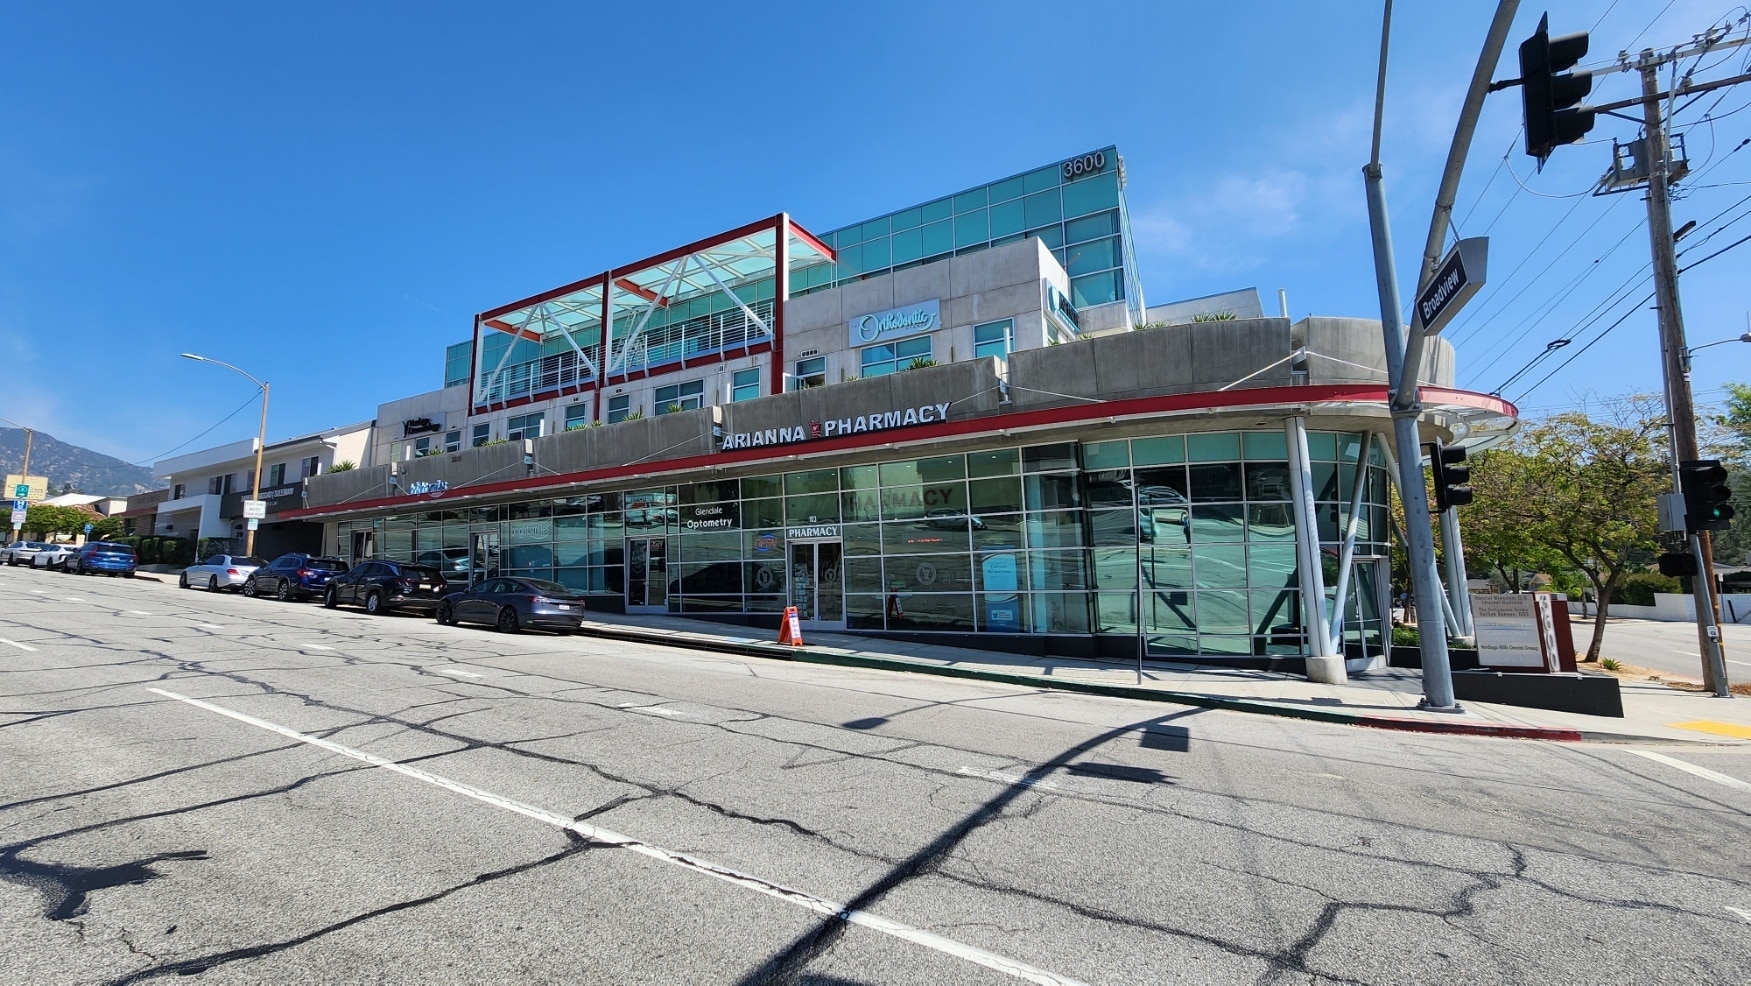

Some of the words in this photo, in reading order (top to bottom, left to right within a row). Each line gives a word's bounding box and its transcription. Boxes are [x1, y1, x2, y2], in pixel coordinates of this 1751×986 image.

[1063, 151, 1105, 178] 3600
[1423, 268, 1459, 320] Broadview
[721, 426, 807, 450] ARIANNA
[824, 402, 951, 436] PHARMACY
[695, 506, 723, 516] Glendale
[686, 518, 733, 530] Optometry
[788, 526, 838, 538] PHARMACY
